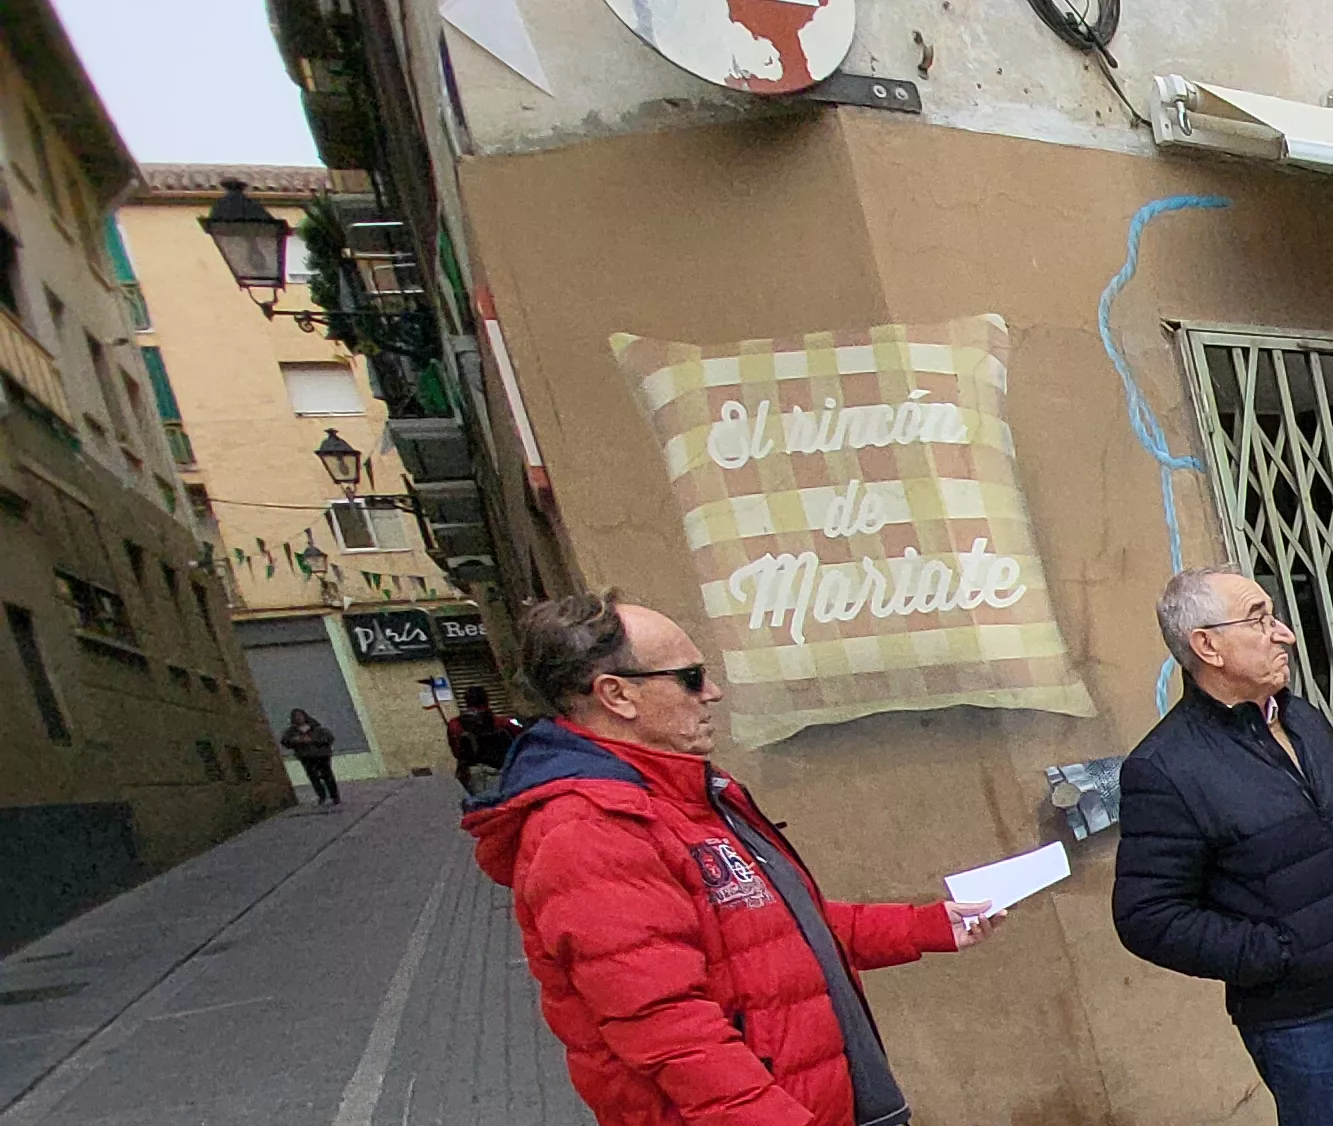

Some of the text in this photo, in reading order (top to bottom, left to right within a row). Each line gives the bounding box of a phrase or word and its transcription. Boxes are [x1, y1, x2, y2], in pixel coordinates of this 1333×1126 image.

[707, 389, 970, 469] El rincón
[823, 479, 884, 538] de
[728, 537, 1027, 646] Mariate
